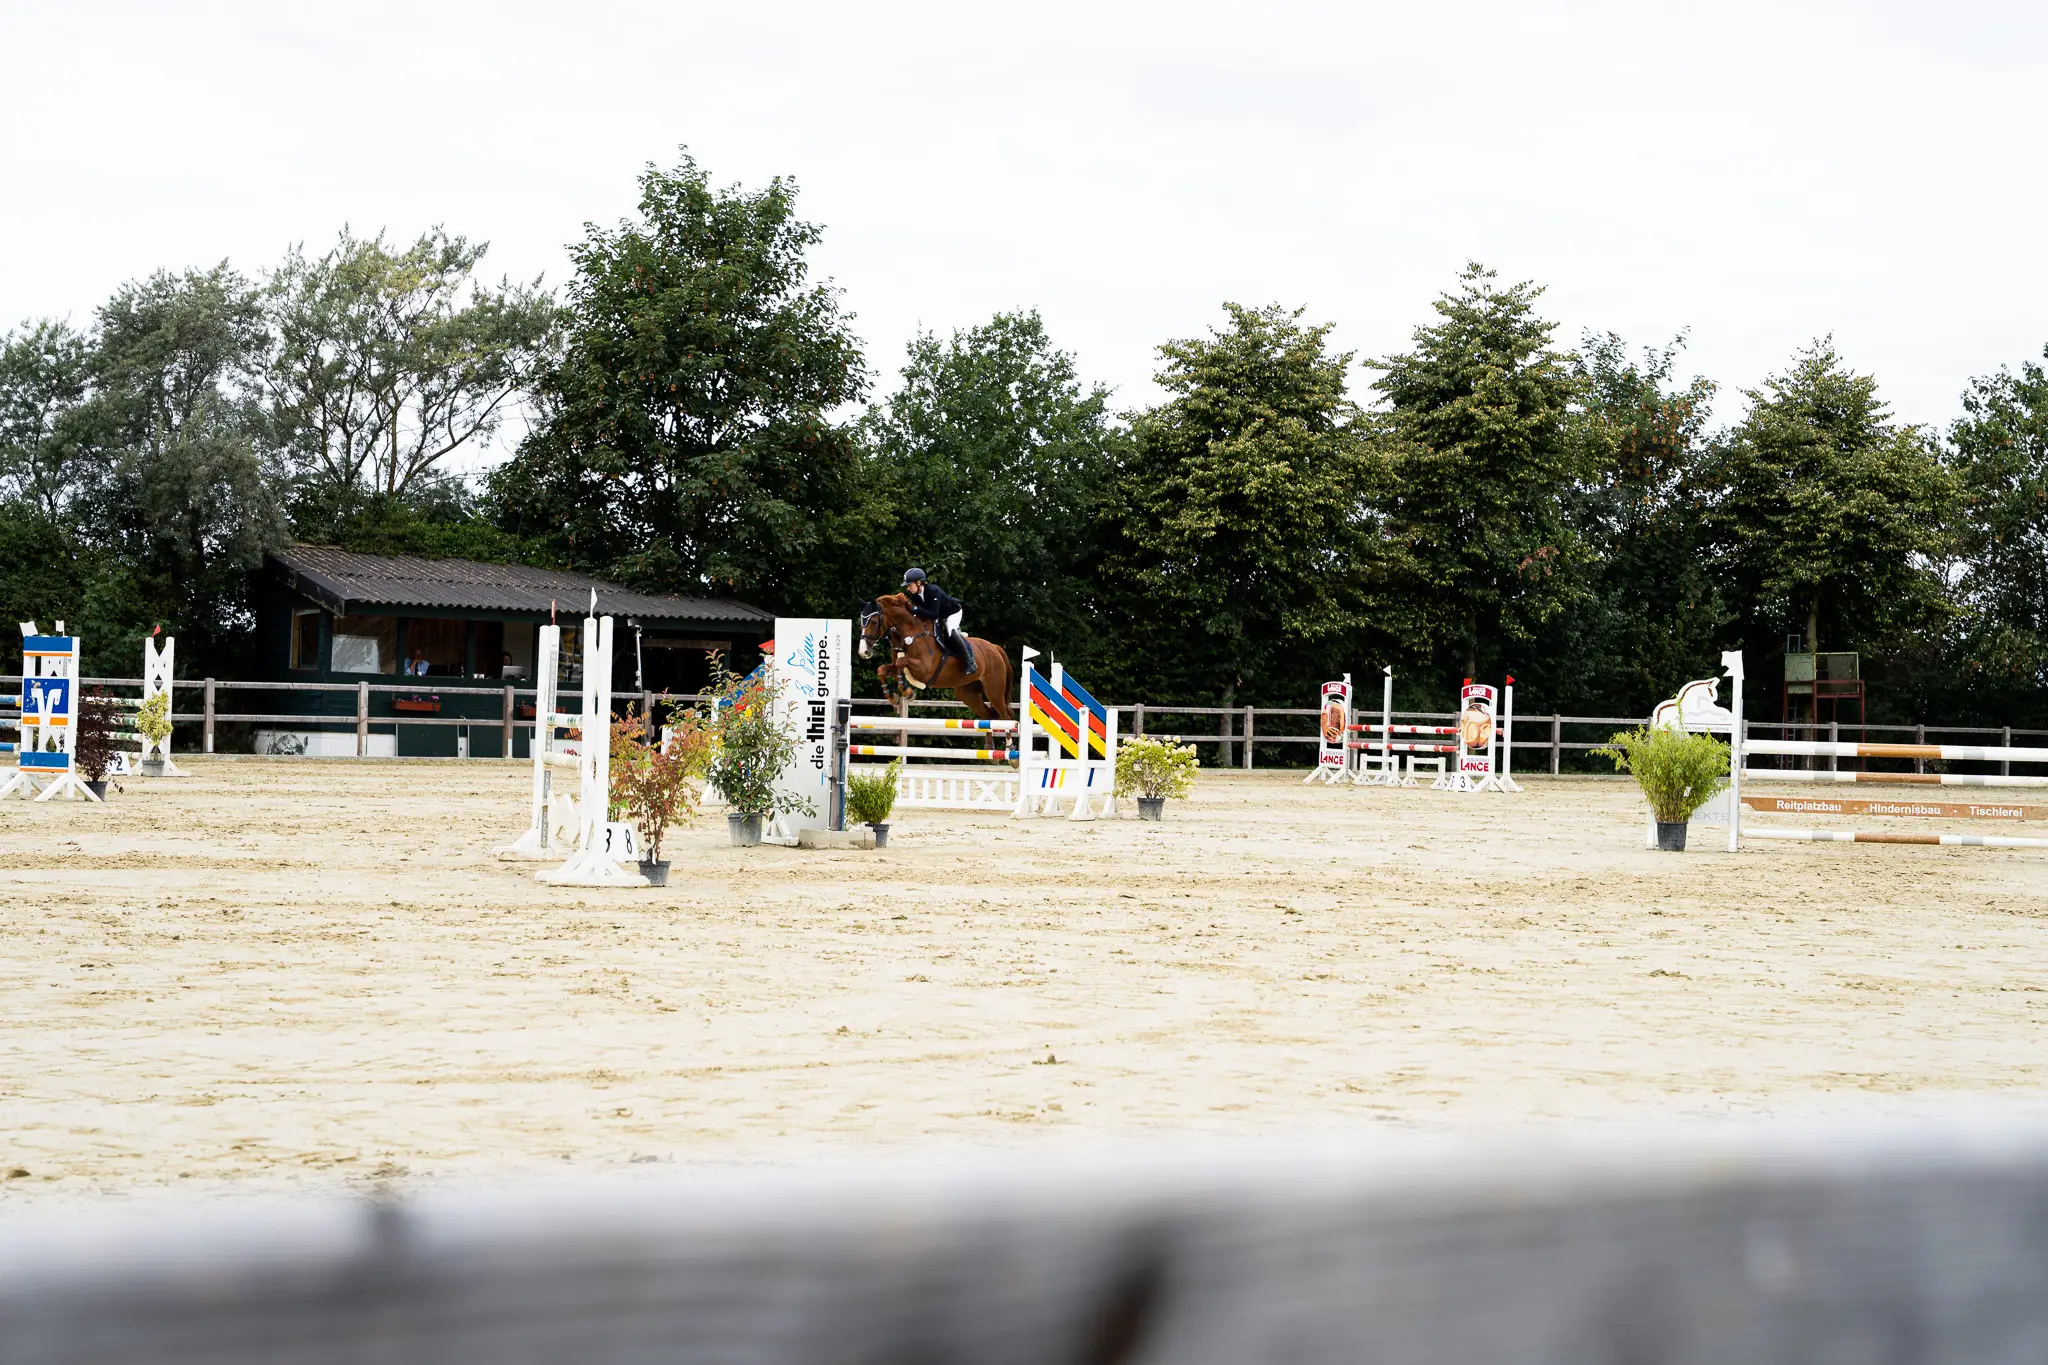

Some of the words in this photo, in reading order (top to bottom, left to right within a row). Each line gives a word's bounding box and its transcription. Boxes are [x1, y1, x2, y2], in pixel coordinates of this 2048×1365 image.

[810, 745, 824, 769] die
[817, 635, 830, 698] gruppe.
[116, 756, 123, 771] 2
[1460, 776, 1466, 789] 3
[1776, 799, 1842, 812] Reitplatzbau
[1869, 803, 1941, 815] Hindernisbau
[1969, 806, 2023, 817] Tischlerei
[1692, 812, 1731, 821] EKTE
[625, 829, 633, 855] 8
